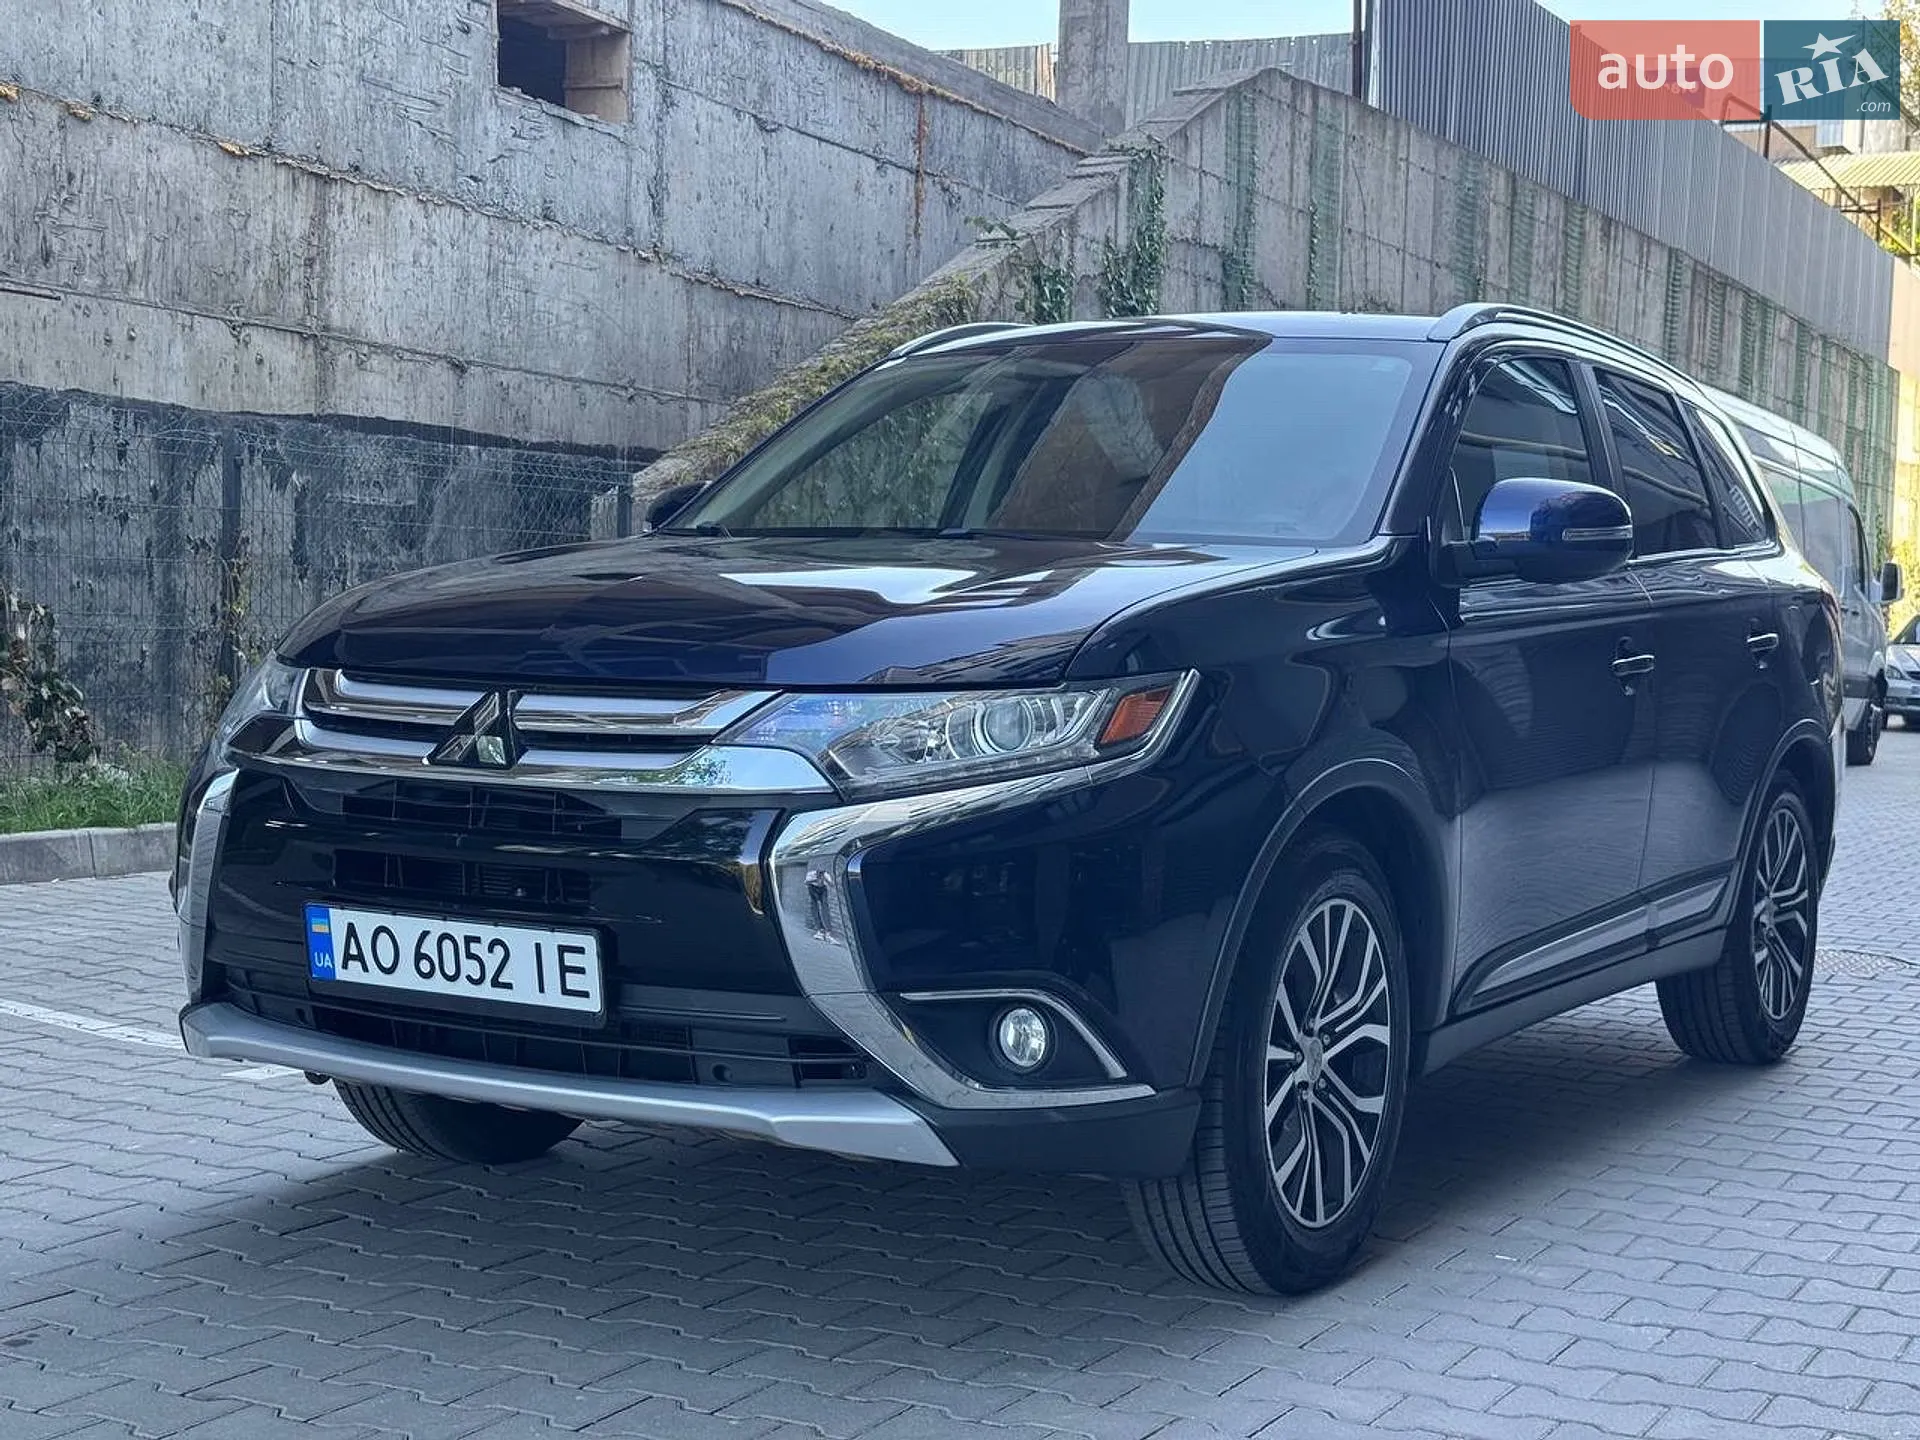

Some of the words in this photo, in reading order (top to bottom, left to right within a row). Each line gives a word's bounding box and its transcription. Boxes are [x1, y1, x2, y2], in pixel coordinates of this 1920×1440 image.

[314, 951, 333, 969] UA
[341, 922, 400, 975] AO
[413, 930, 514, 990] 6052
[534, 942, 591, 999] IE
